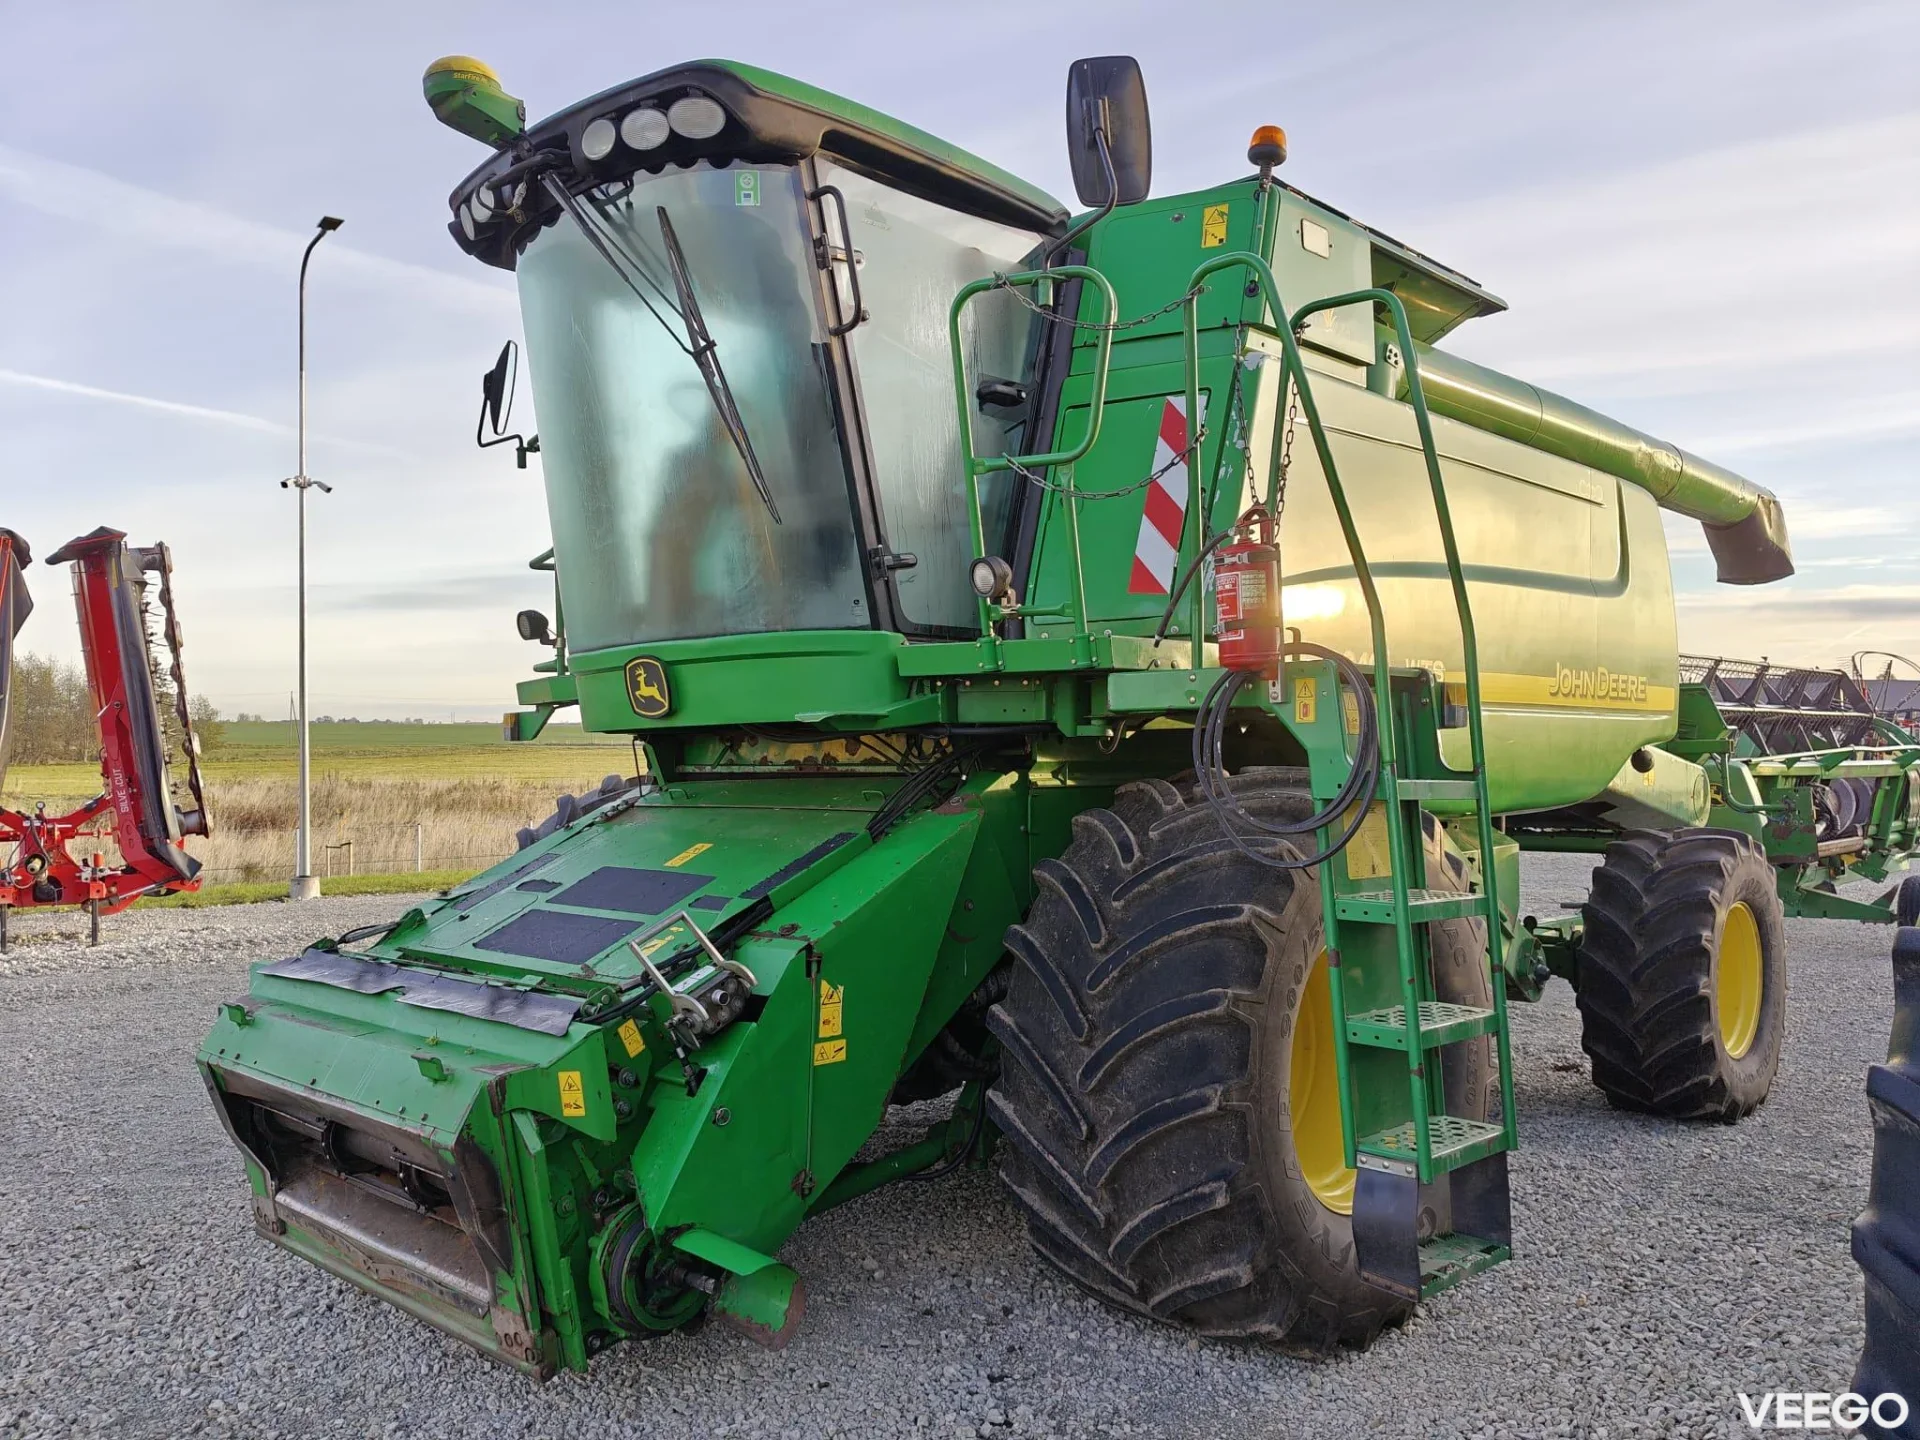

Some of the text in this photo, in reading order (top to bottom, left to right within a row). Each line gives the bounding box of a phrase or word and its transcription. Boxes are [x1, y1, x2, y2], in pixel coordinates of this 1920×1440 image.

[1548, 660, 1648, 703] JOHN DEERE
[112, 768, 129, 813] SILVECUT
